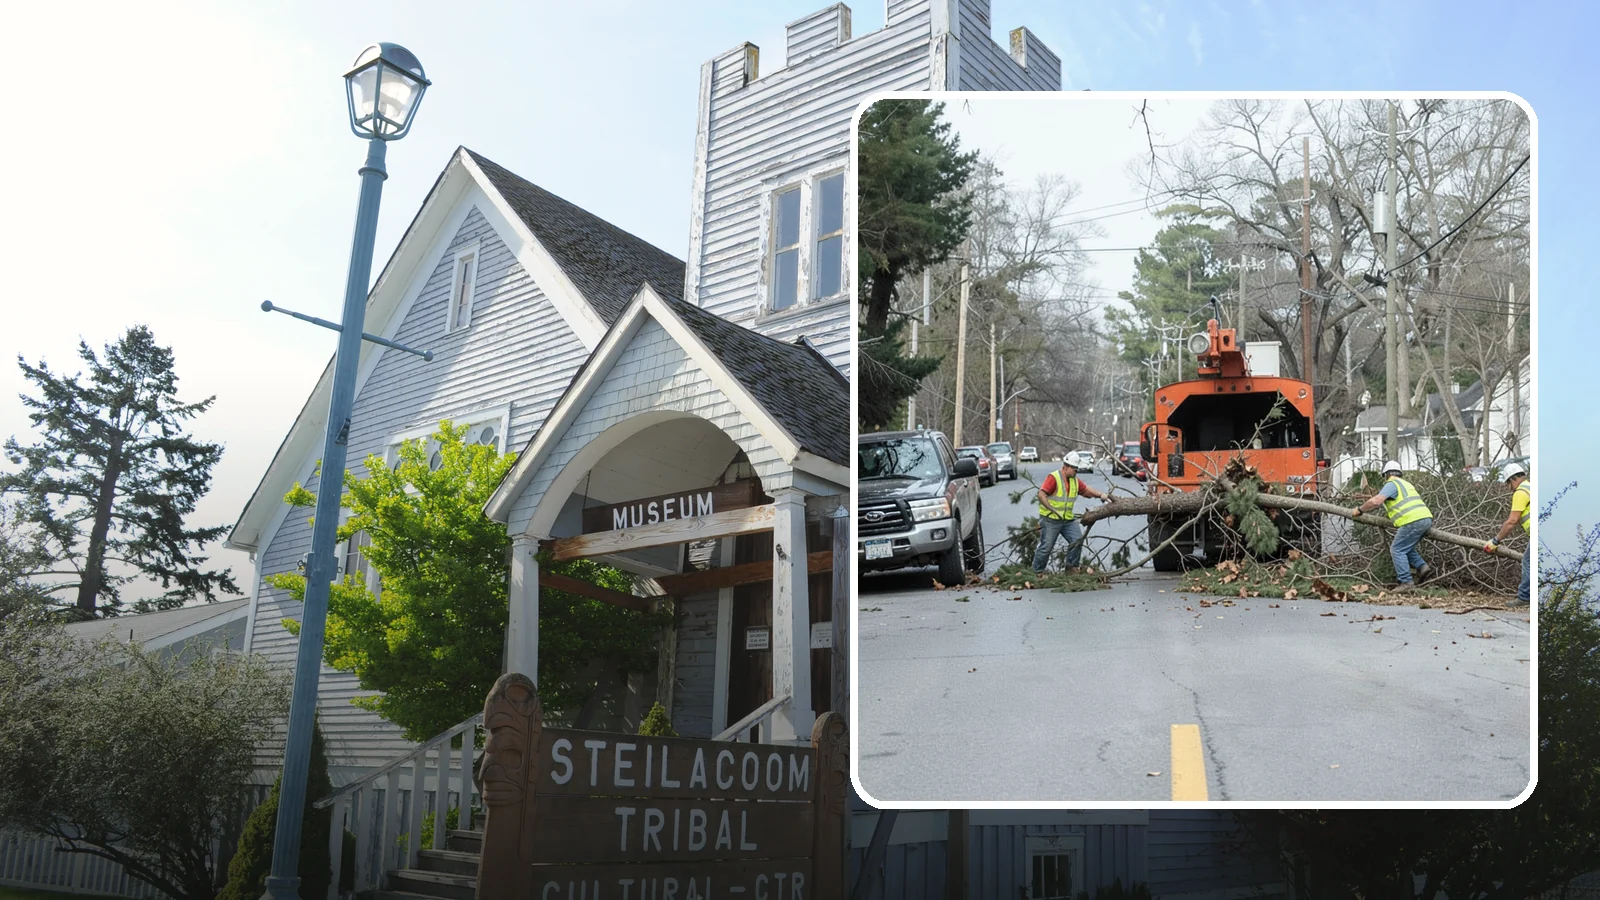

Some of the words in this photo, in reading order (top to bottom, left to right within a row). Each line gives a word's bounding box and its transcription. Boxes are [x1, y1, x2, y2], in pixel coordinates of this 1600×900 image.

[612, 491, 713, 531] MUSEUM
[551, 738, 809, 792] STEILACOOM
[615, 806, 758, 851] TRIBAL
